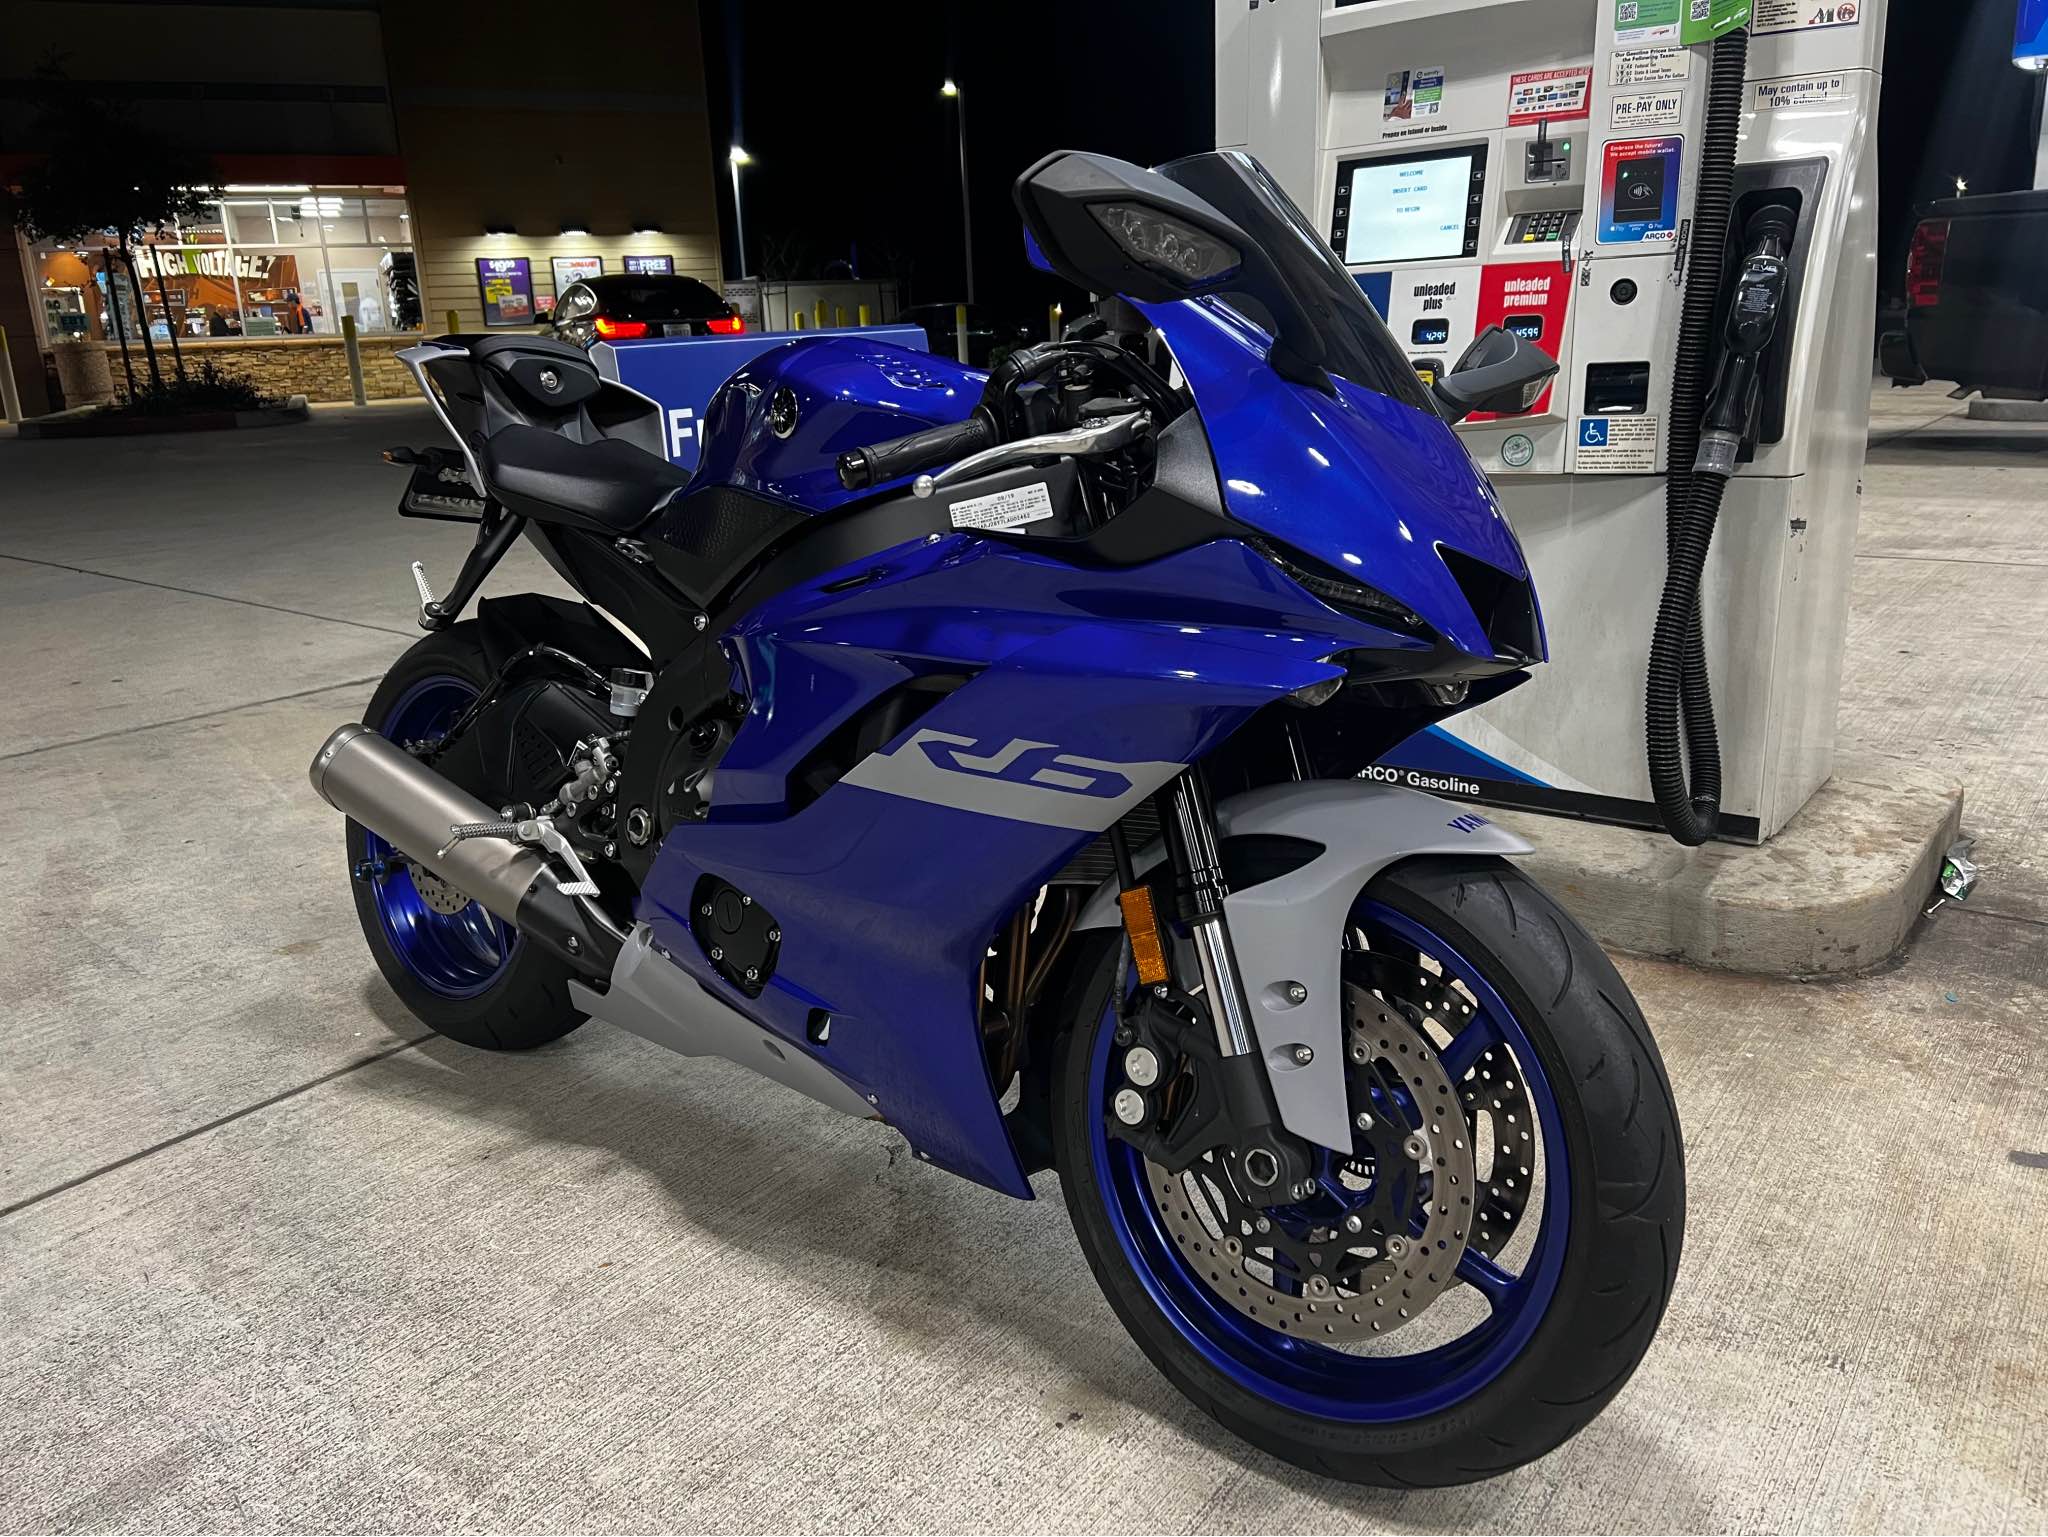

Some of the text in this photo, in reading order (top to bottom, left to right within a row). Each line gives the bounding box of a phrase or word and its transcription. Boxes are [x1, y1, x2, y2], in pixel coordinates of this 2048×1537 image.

[1554, 68, 1577, 78] ACCEPTED
[1758, 79, 1840, 97] May contain up to
[1769, 90, 1791, 102] 10%
[1615, 98, 1678, 114] PRE-PAY ONLY
[1610, 144, 1634, 152] Embrace
[1399, 169, 1424, 177] WELCOME
[1645, 232, 1666, 240] ARCO
[135, 249, 190, 279] HIGH
[640, 259, 667, 270] FREE
[1413, 281, 1456, 297] unleaded
[1504, 277, 1551, 293] unleaded
[1423, 296, 1443, 311] plus
[1504, 292, 1548, 308] premium
[1407, 771, 1480, 795] Gasoline
